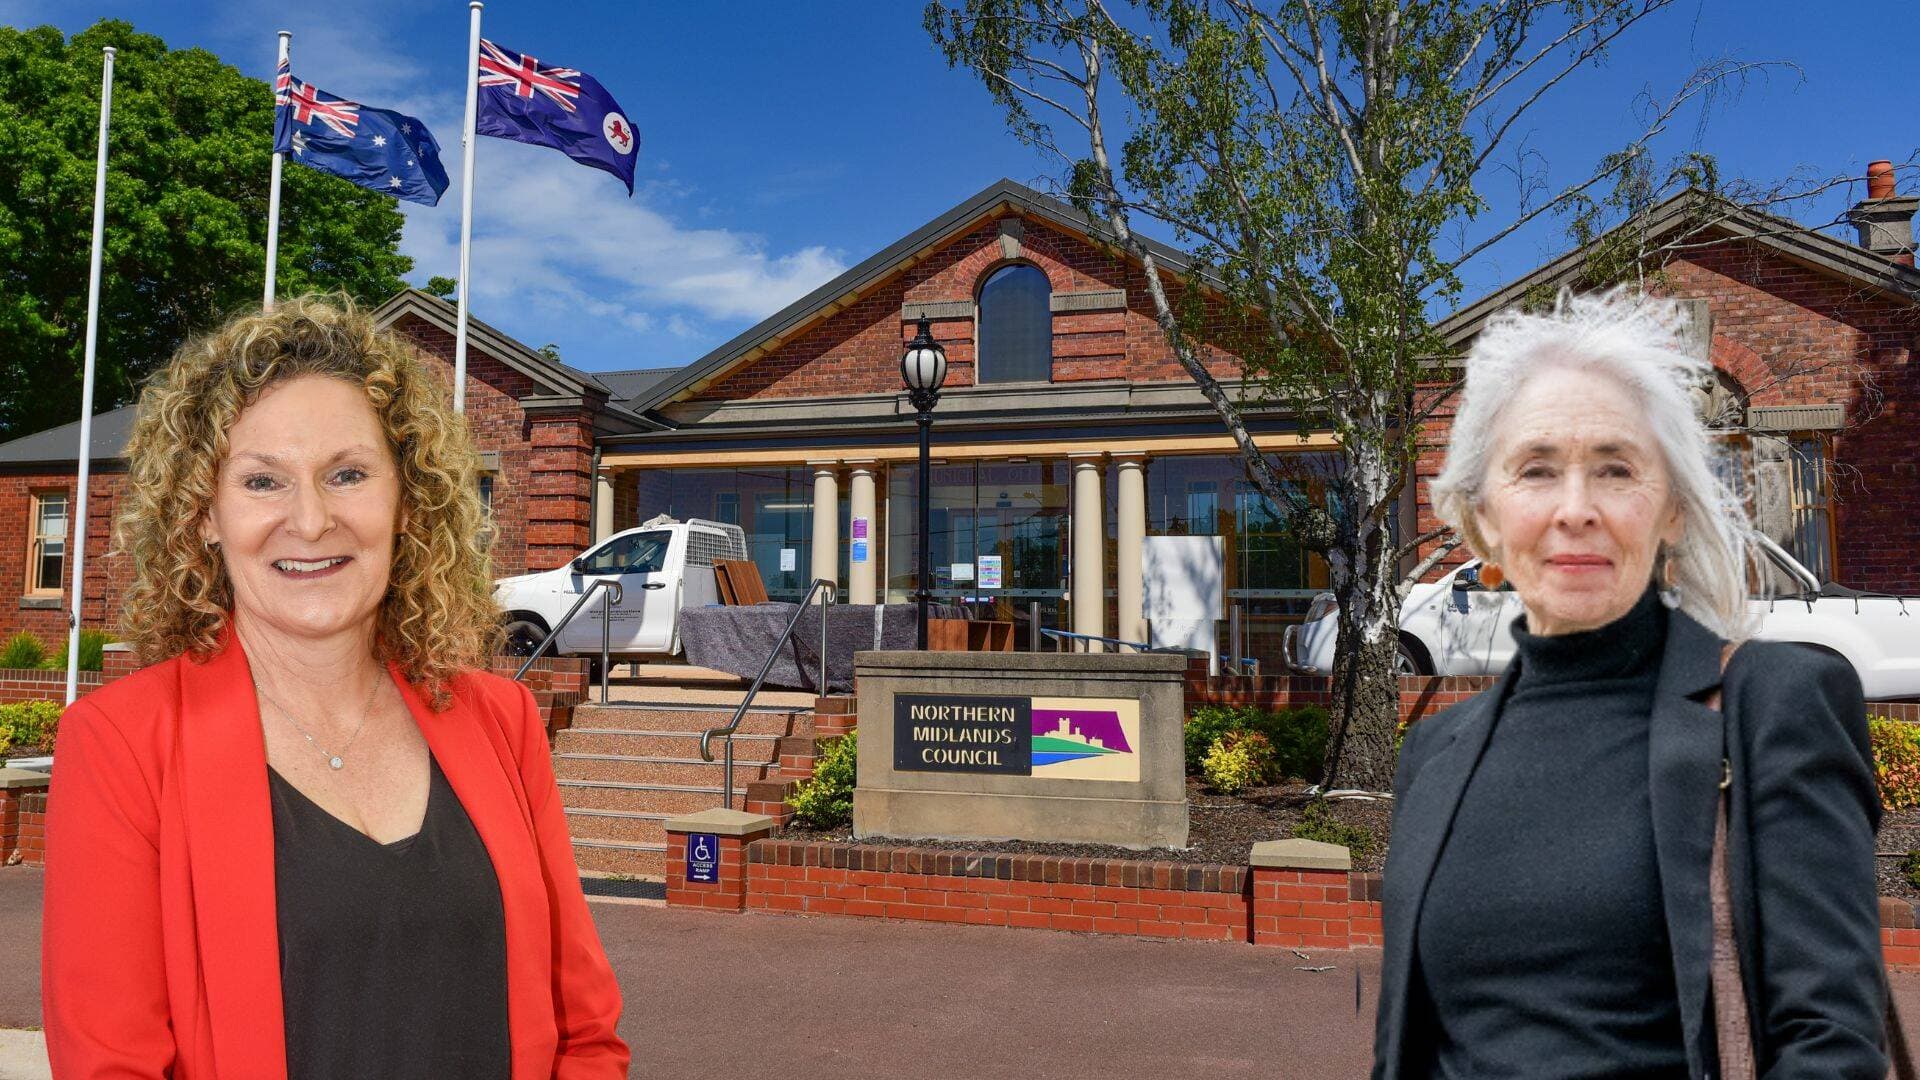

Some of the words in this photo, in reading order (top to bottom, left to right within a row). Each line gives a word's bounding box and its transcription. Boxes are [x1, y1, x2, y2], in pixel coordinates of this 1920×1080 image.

[911, 705, 1015, 722] NORTHERN
[913, 726, 1012, 744] MIDLANDS
[922, 748, 1002, 766] COUNCIL
